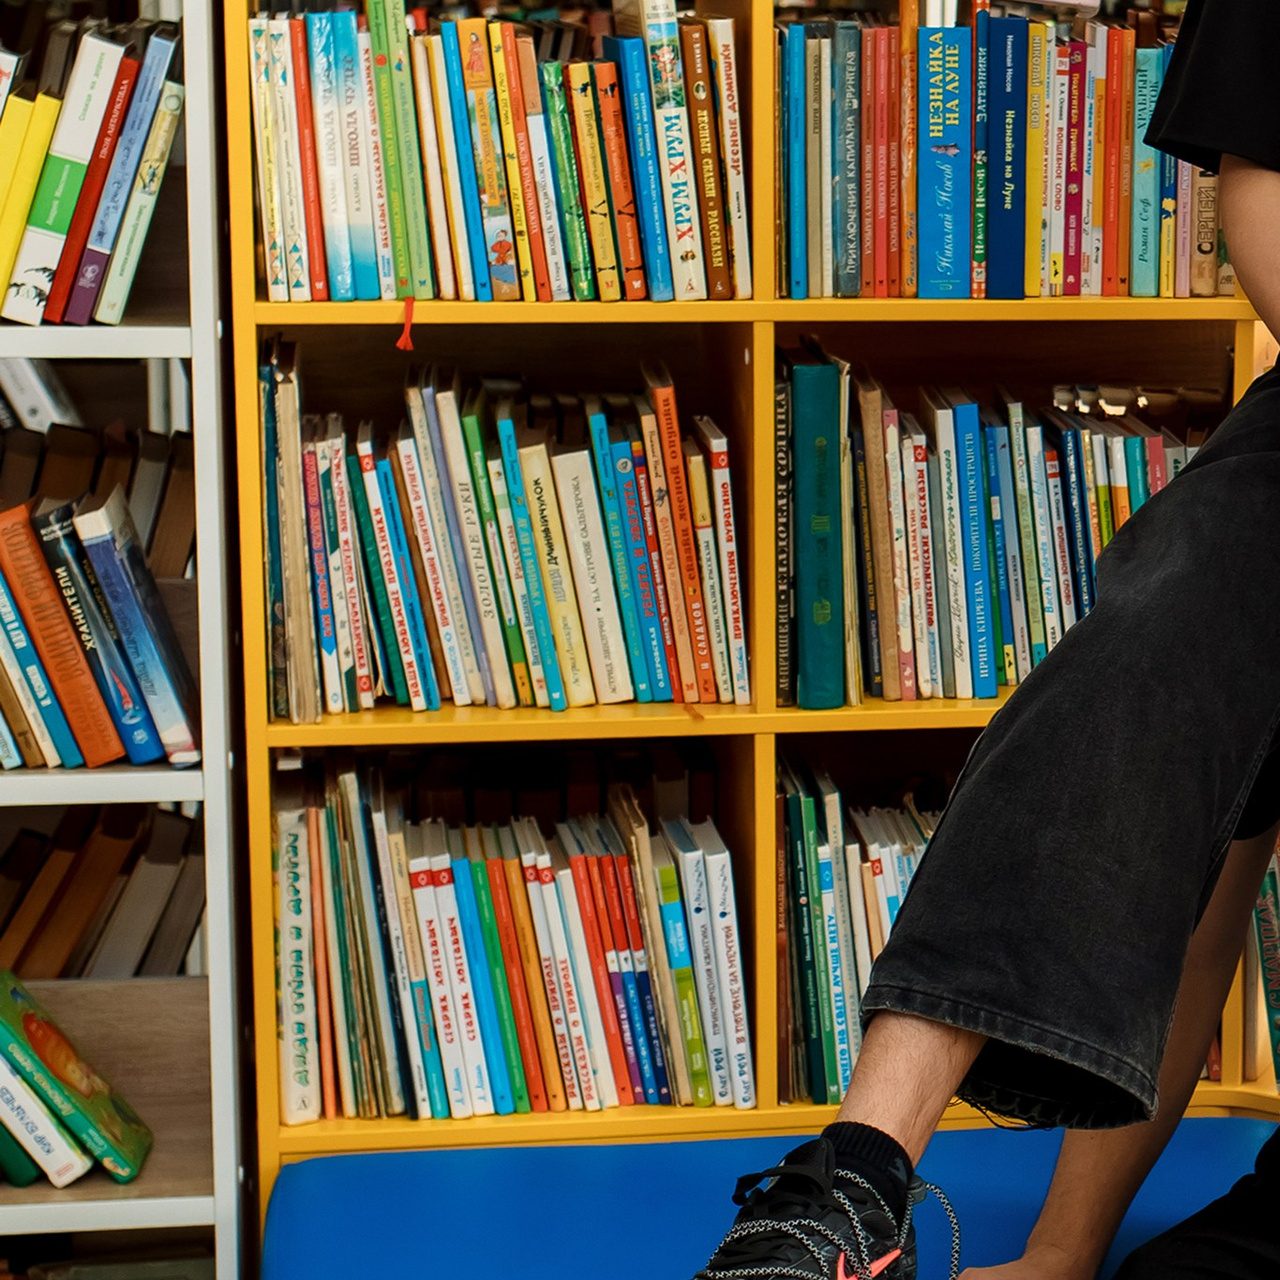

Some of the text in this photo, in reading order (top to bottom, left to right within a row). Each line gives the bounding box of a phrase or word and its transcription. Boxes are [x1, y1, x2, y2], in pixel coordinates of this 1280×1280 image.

[927, 31, 944, 138] НЕЗНАЙКА
[945, 44, 960, 125] НА ЛУНЕ
[1005, 35, 1014, 92] Николай Носов
[1030, 35, 1042, 129] НИКОЛАЙ НОСОВ
[347, 110, 361, 167] ШКОЛА
[662, 113, 695, 242] ХРУМ-ХРУМ
[846, 115, 856, 178] КАПИТАНА
[1003, 110, 1015, 210] Незнайка на Луне
[1053, 126, 1064, 211] ВОЛШЕБНОЕ СЛОВО
[846, 183, 857, 274] ПРИКЛЮЧЕНИЯ
[934, 160, 955, 276] Николай Носов
[1138, 198, 1150, 263] Роман Сеф
[1199, 186, 1216, 255] СЕРГЕЙ
[963, 432, 982, 571] ПОКОРИТЕЛИ ПРОСТРАНСТВ
[458, 481, 495, 619] ЗОЛОТЫЕ РУКИ
[507, 525, 523, 580] Рассказы
[720, 481, 743, 640] ПРИКЛЮЧЕНИЯ БУРАТИНО
[55, 565, 96, 651] ХРАНИТЕЛИ
[974, 580, 989, 678] ИРИНА КИРЕЕВА
[426, 919, 455, 1044] СТАРИК ХОТТАБЫЧ
[447, 917, 477, 1041] СТАРИК ХОТТАБЫЧ
[723, 924, 737, 968] МЕЧТОЙ
[728, 970, 739, 985] ЗА
